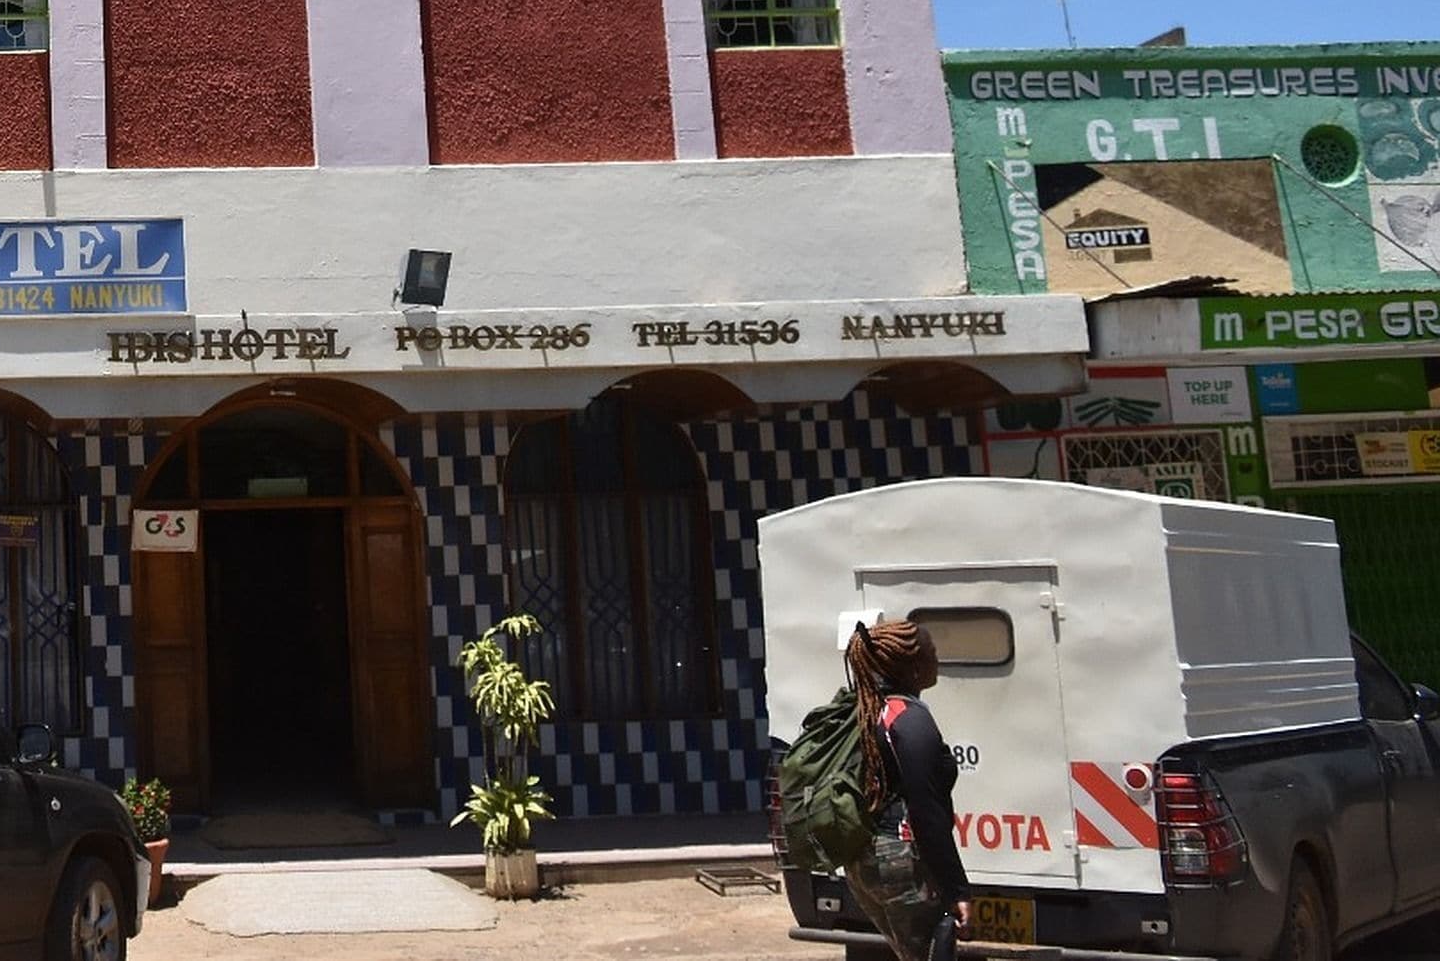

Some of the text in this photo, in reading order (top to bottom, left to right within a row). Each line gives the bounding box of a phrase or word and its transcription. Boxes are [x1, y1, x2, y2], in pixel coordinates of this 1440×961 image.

[970, 69, 1102, 100] GREEN
[1123, 66, 1359, 99] TREASURES
[1068, 229, 1144, 248] EQUITY
[1265, 308, 1365, 339] PESA
[107, 329, 194, 363] IBIS
[200, 328, 351, 361] HOTEL
[449, 325, 523, 350] BOX
[529, 323, 592, 350] 286
[632, 322, 698, 347] TEL
[704, 319, 801, 346] 31536
[841, 311, 1007, 340] NANYUKI
[1184, 380, 1232, 392] TOP UP
[1190, 393, 1230, 405] HERE
[146, 514, 186, 537] G4S
[953, 745, 979, 765] 80
[954, 813, 1051, 851] YOTA
[971, 899, 1011, 926] CM
